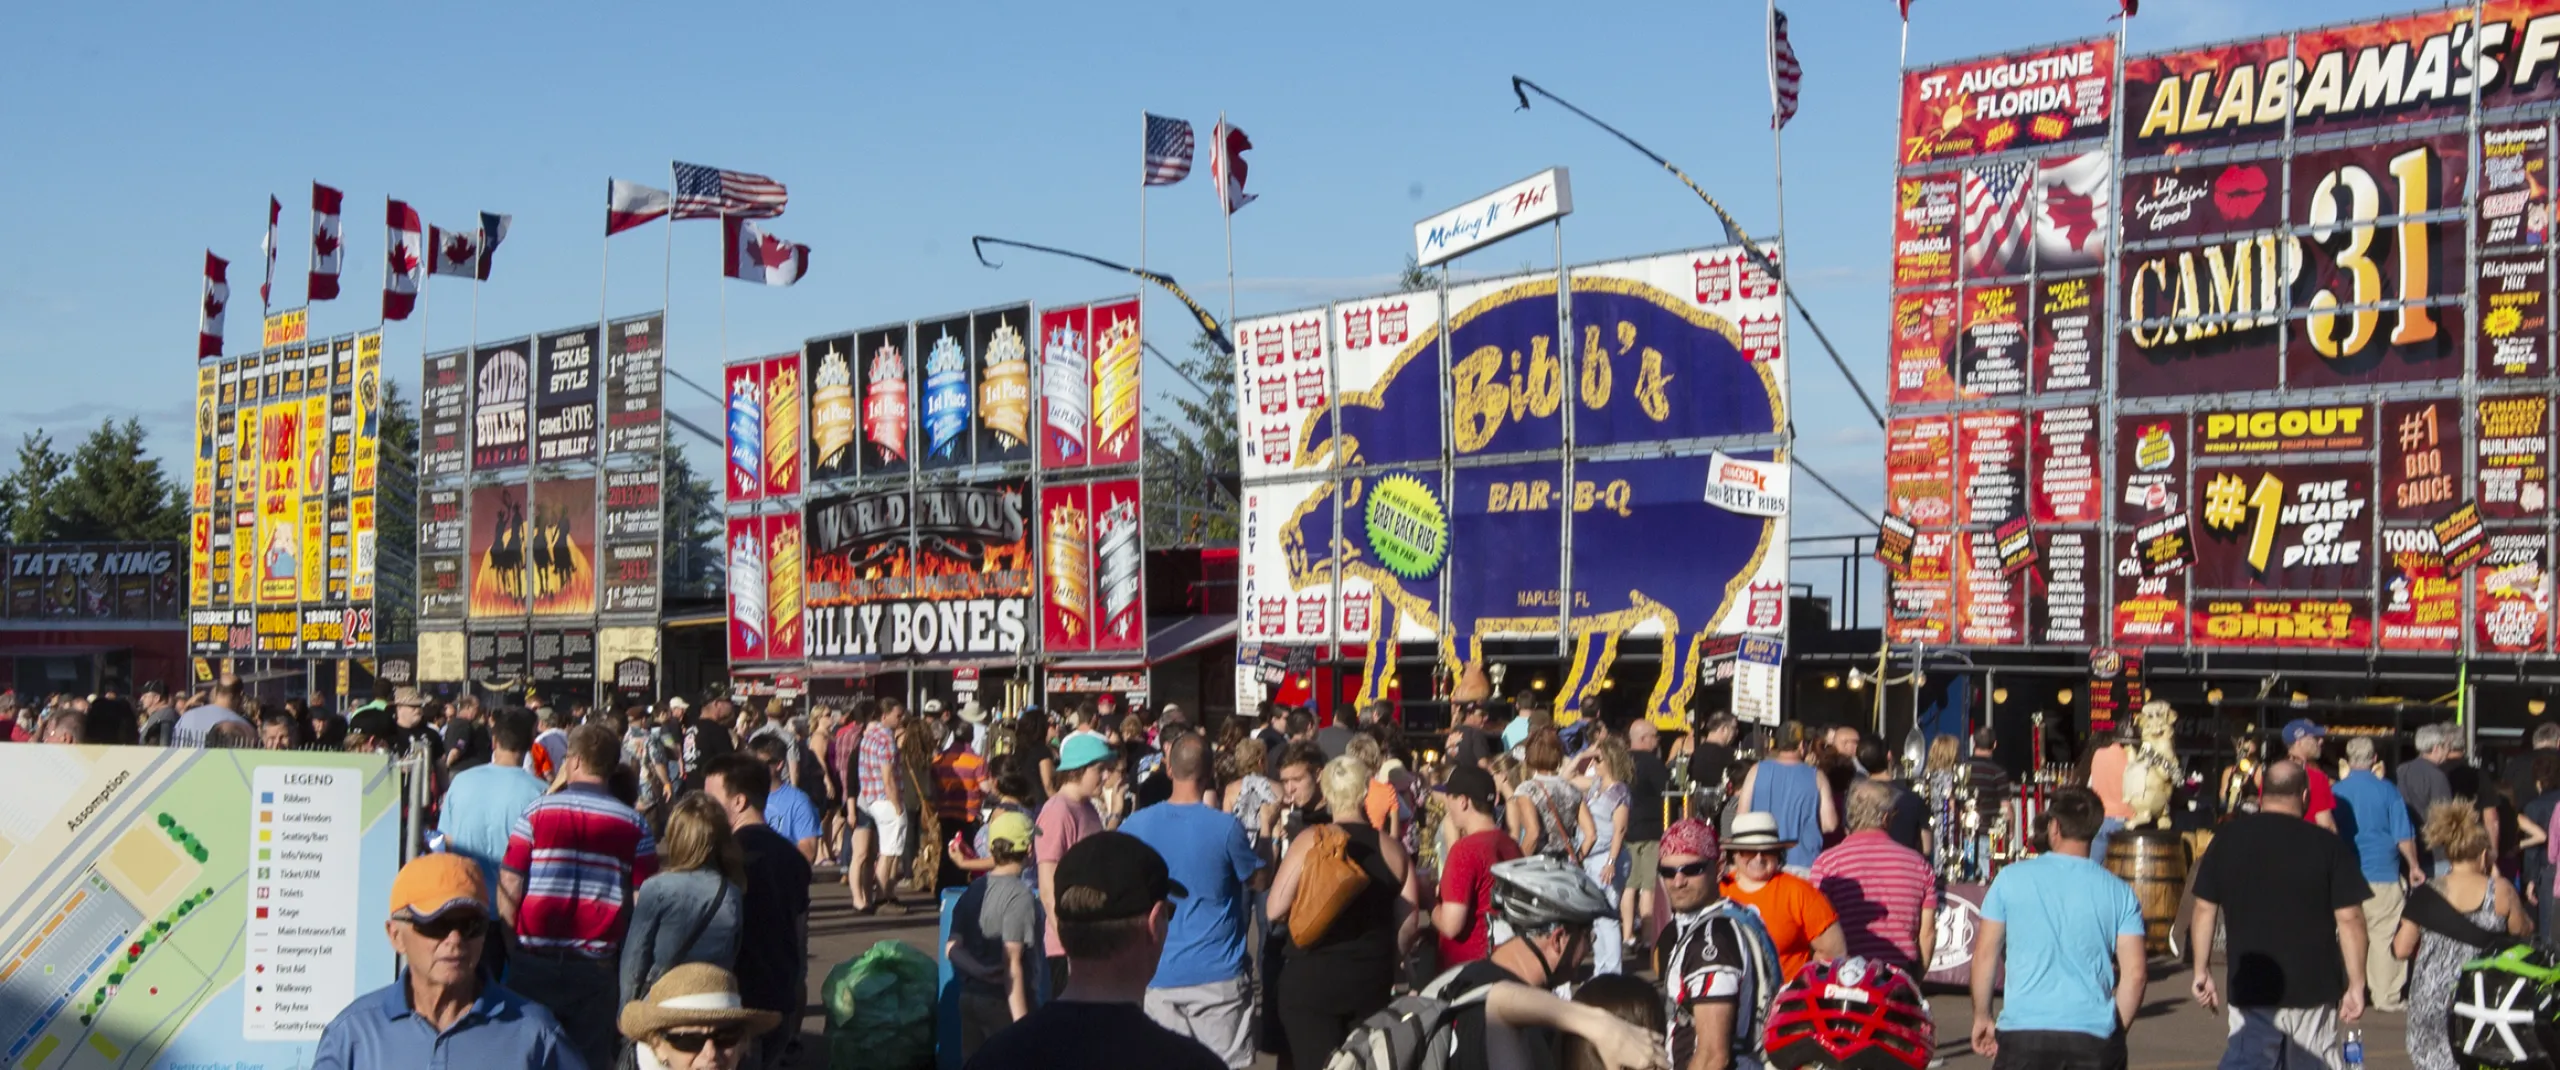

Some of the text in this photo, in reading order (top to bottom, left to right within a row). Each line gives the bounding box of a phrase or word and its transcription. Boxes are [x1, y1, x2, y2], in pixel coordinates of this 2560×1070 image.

[1920, 51, 2094, 101] ST. AUGUSTINE
[2138, 22, 2511, 139] ALABAMA'S
[1976, 83, 2071, 120] FLORIDA
[2156, 178, 2179, 197] Lip
[2135, 180, 2208, 220] Smackin'
[1423, 184, 1550, 253] Making It Hot
[2150, 206, 2191, 231] Good
[2131, 146, 2438, 358] CAMP 31
[2482, 258, 2545, 278] Richmond
[2502, 275, 2526, 292] Hill
[266, 324, 305, 346] CANADIAN
[625, 321, 649, 337] LONDON
[551, 346, 590, 370] TEXAS
[1239, 331, 1252, 405] BEST
[478, 350, 528, 407] SILVER
[550, 369, 589, 394] STYLE
[928, 392, 967, 414] 1st Place
[985, 380, 1026, 404] 1st Place
[817, 405, 852, 425] 1st Place
[868, 401, 905, 419] 1st Place
[2479, 396, 2546, 413] CANADA'S
[476, 408, 527, 447] BULLET
[539, 404, 594, 436] COME BITE
[1050, 406, 1081, 429] 1st PLACE
[2208, 407, 2363, 440] PIGOUT
[2399, 403, 2439, 452] #1
[2481, 411, 2542, 426] LARGEST
[540, 437, 589, 460] THE BULLET
[2205, 441, 2279, 453] WORLD FAMOUS
[2479, 436, 2546, 456] BURLINGTON
[2405, 449, 2442, 479] BBQ
[1723, 484, 1785, 512] BEEF RIBS
[2298, 479, 2348, 503] THE
[2396, 474, 2453, 509] SAUCE
[1382, 489, 1439, 524] WE HAVE THE ONLY
[2281, 499, 2365, 525] HEART
[817, 492, 1023, 553] WORLD FAMOUS
[1373, 500, 1437, 555] BABY BACK RIBS
[2204, 471, 2284, 573] #1
[2301, 521, 2344, 546] OF
[1380, 537, 1418, 563] IN THE PARK
[2383, 529, 2439, 553] TORON
[2490, 534, 2546, 549] ISSISSAUGA
[12, 551, 172, 576] TATER KING
[1246, 496, 1257, 637] BABY BACKS
[2282, 541, 2361, 569] DIXIE
[619, 560, 648, 580] 2013
[850, 577, 911, 595] CHICKEN
[924, 574, 968, 593] PORK
[977, 569, 1028, 589] SAUCE
[2136, 577, 2167, 594] 2014
[2412, 576, 2425, 601] 4
[1575, 591, 1590, 608] FL
[192, 625, 229, 642] BEST RIBS
[803, 598, 1025, 656] BILLY BONES
[618, 676, 650, 687] BULLET
[284, 774, 333, 785] LEGEND
[67, 769, 130, 832] Assomption
[283, 794, 311, 804] Ribbers
[282, 813, 332, 823] Local Vendors
[282, 832, 329, 844] Seating/Bars
[281, 851, 322, 862] Info/Voting
[280, 869, 320, 879] Ticket/ATM
[280, 889, 303, 898] Tickets
[279, 907, 299, 918] Stage
[277, 927, 346, 937] Main Entrance/Exit
[277, 945, 333, 957] Emergency Exit
[276, 964, 306, 974] First Aid
[276, 984, 313, 995] Walkways
[275, 1003, 309, 1013] Play Area
[273, 1021, 326, 1033] Security Fence
